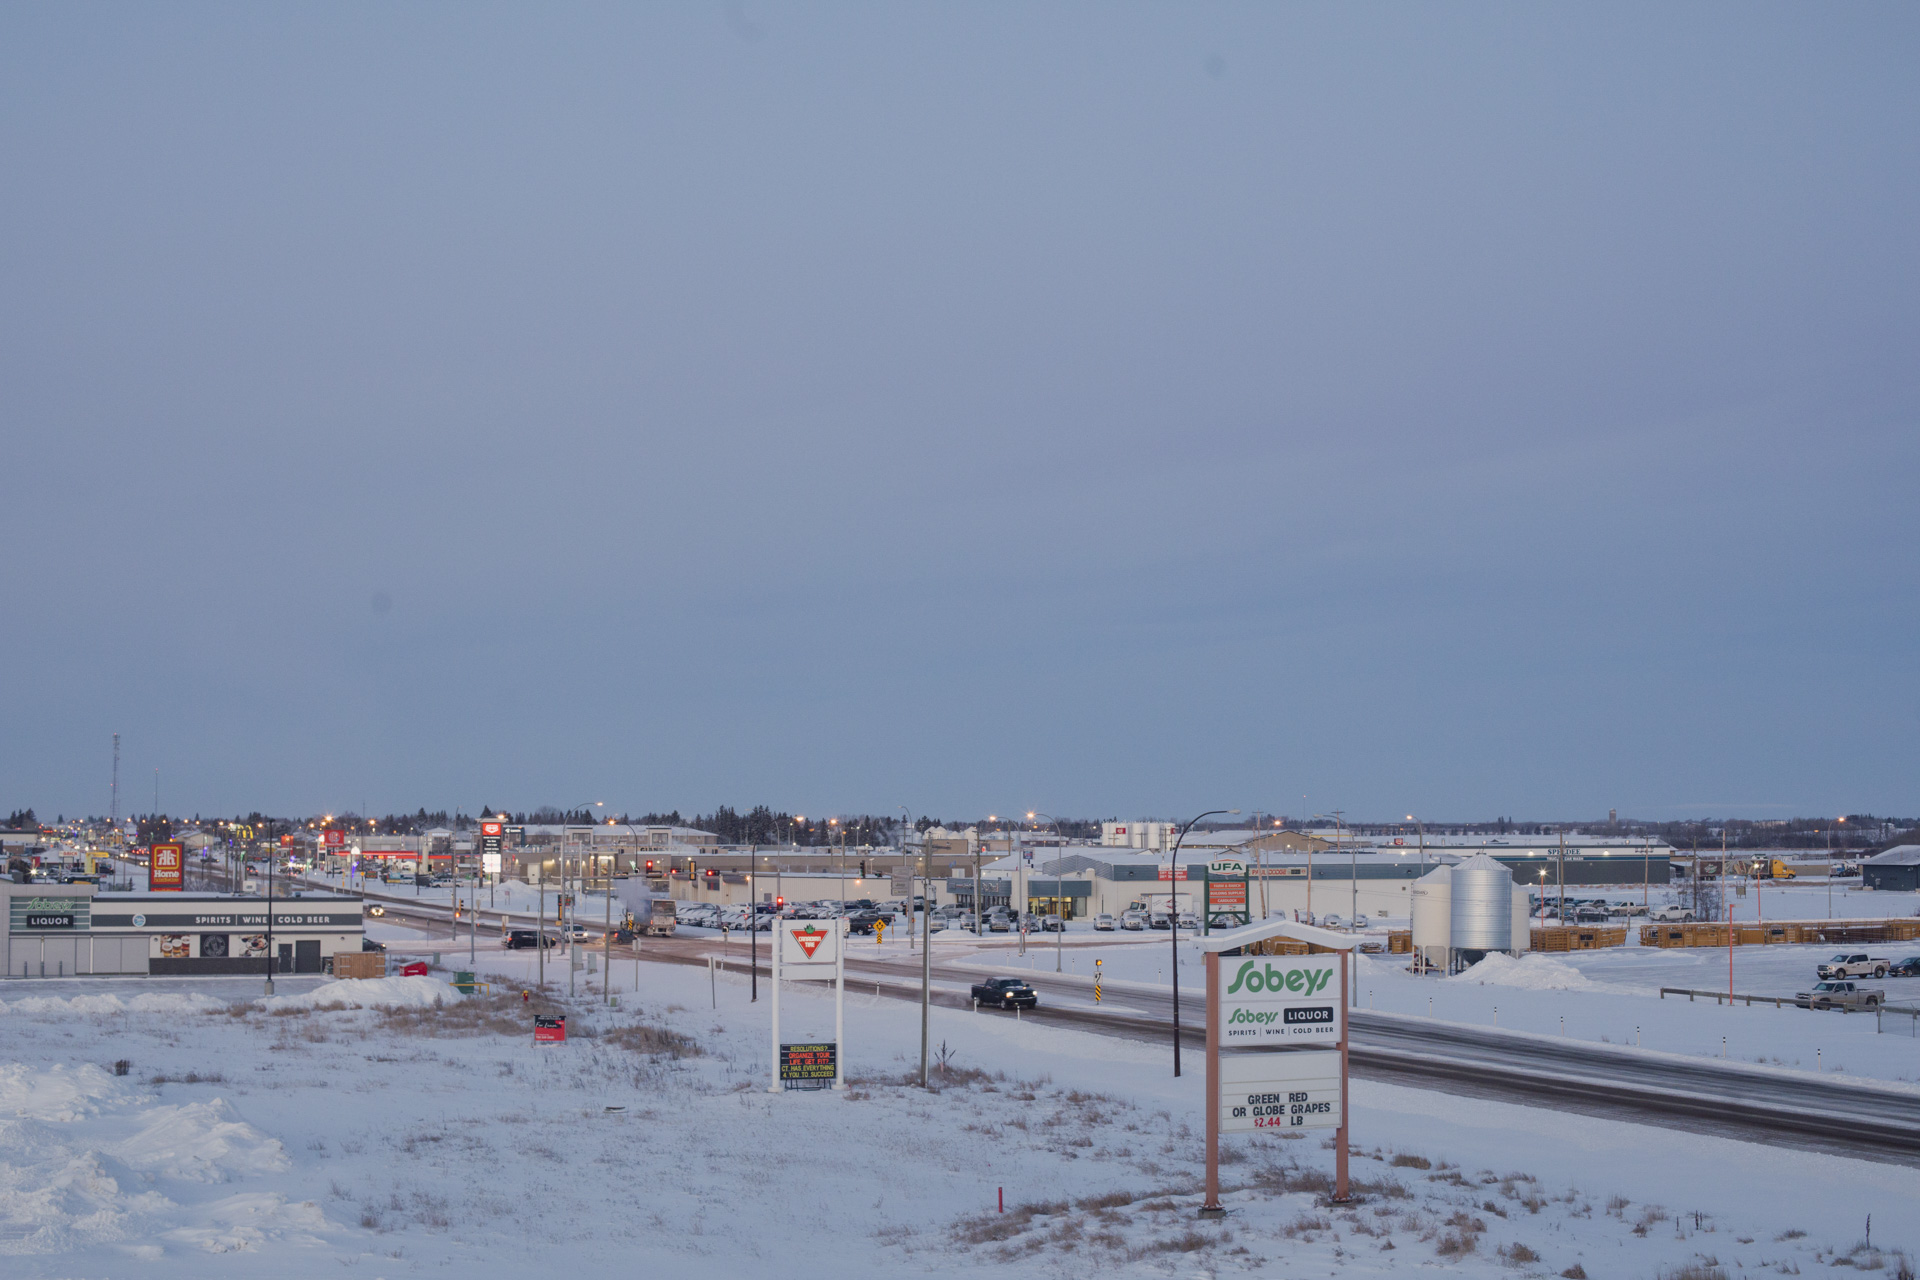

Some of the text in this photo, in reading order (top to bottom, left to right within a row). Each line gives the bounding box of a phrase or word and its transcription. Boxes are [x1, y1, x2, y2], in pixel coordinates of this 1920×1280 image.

[1211, 863, 1242, 871] UFA
[154, 869, 180, 878] Home
[31, 917, 69, 925] LIQUOR
[195, 916, 232, 924] SPIRITS
[242, 916, 268, 924] WINE
[278, 916, 303, 924] COLD
[1227, 960, 1333, 996] Sobeys
[1228, 1008, 1329, 1025] Sobeys LIQUOR
[1247, 1092, 1308, 1105] GREEN RED
[1232, 1102, 1331, 1117] OR GLOBE GRAPES
[1254, 1116, 1304, 1128] $2.44 LB
